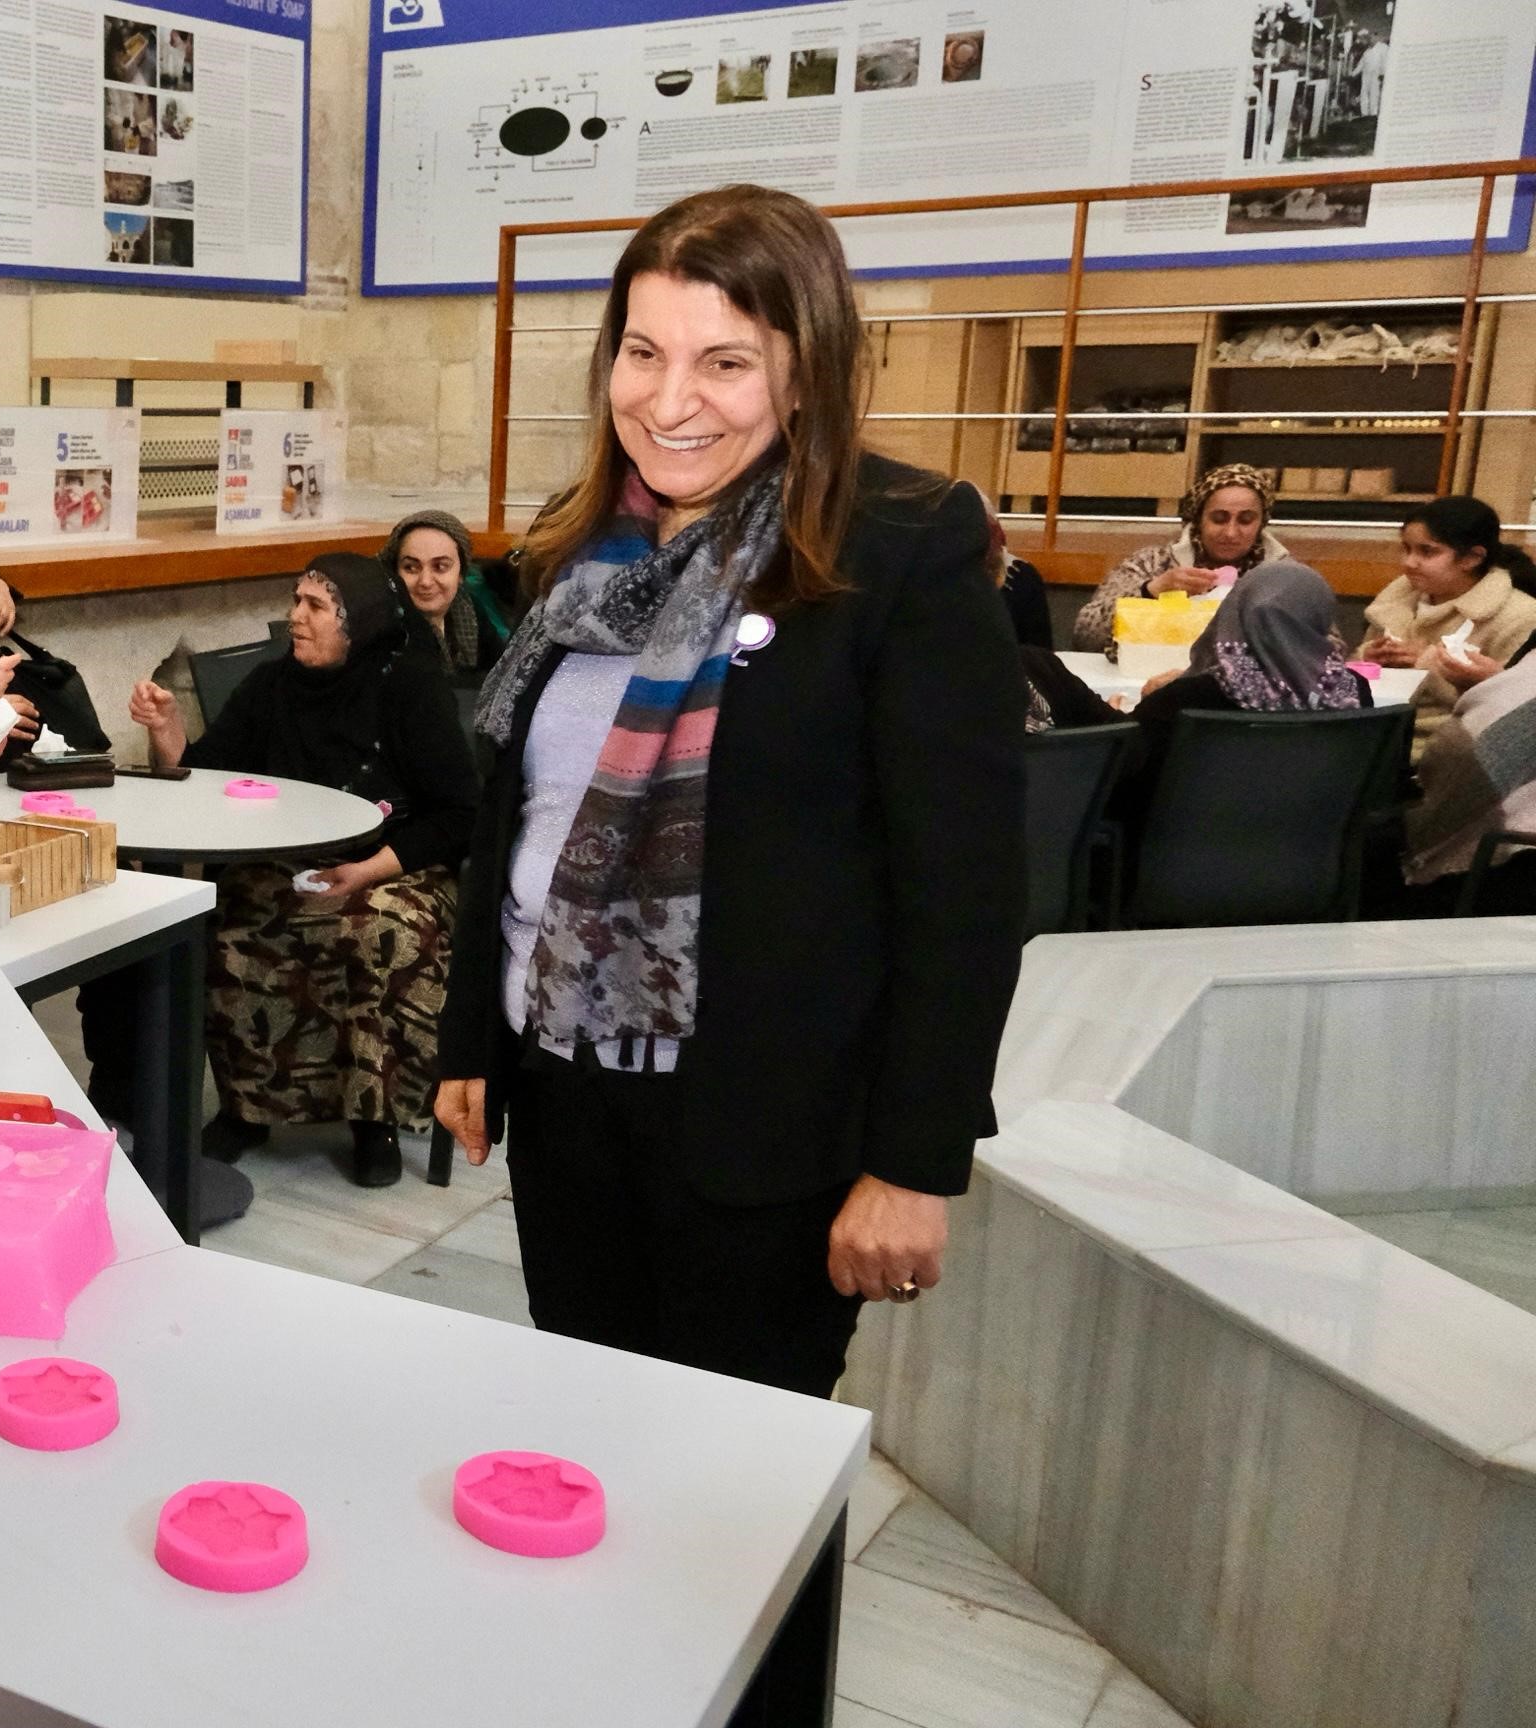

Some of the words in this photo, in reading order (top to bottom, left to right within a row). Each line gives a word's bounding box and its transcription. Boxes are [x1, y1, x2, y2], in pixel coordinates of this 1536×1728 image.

[1140, 74, 1152, 91] S
[639, 121, 651, 135] A
[56, 432, 68, 462] 5
[283, 432, 292, 458] 6
